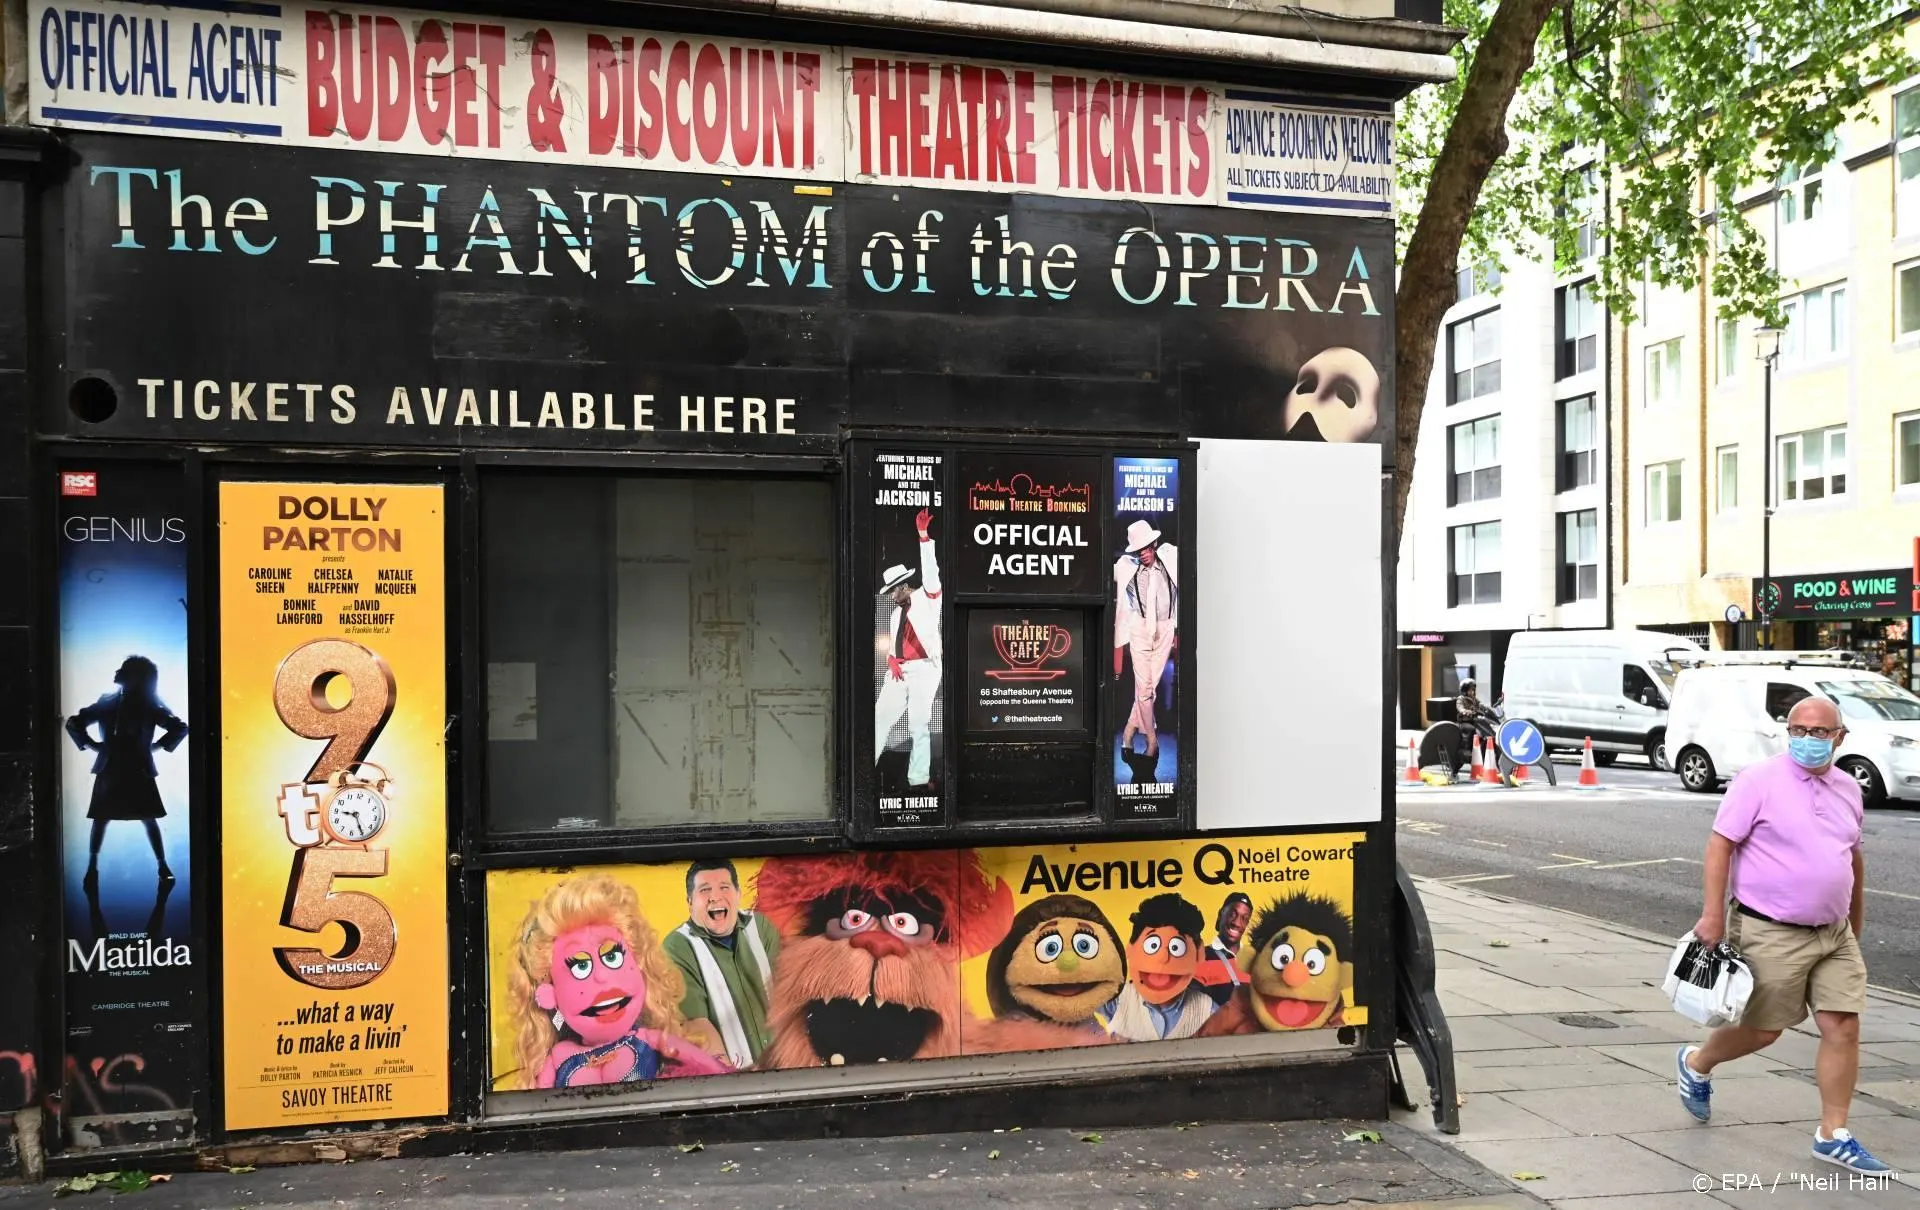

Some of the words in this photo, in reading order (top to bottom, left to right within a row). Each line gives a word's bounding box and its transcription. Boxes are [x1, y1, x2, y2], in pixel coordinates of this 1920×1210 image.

[40, 6, 177, 98] OFFICIAL
[187, 22, 282, 107] AGENT
[305, 9, 506, 149] BUDGET
[526, 27, 566, 154] &
[587, 32, 822, 171] DISCOUNT
[851, 56, 1037, 184] THEATRE
[1052, 74, 1210, 197] TICKETS
[1226, 108, 1275, 157] ADVANCE
[1279, 112, 1337, 161] BOOKINGS
[1340, 117, 1391, 164] WELCOME
[1227, 167, 1242, 186] ALL
[1245, 168, 1281, 189] TICKETS
[1284, 171, 1321, 191] SUBJECT
[1323, 174, 1335, 192] TO
[1338, 175, 1391, 196] AVAILABILITY
[90, 165, 278, 256] The
[308, 175, 834, 290] PHANTOM
[860, 209, 944, 294] of
[970, 214, 1079, 300] the
[1111, 226, 1382, 316] OPERA
[137, 378, 356, 424] TICKETS
[386, 386, 655, 431] AVAILABLE
[680, 395, 797, 435] HERE
[905, 455, 915, 463] THE
[884, 464, 934, 480] MICHAEL
[64, 474, 95, 487] RSC
[910, 481, 920, 489] THE
[1124, 473, 1168, 488] MICHAEL
[875, 489, 930, 506] JACKSON
[934, 491, 942, 507] 5
[973, 496, 1005, 511] LONDON
[1009, 497, 1042, 512] THEATRE
[1047, 498, 1086, 513] BOOKINGS
[1117, 497, 1164, 511] JACKSON
[1166, 498, 1174, 511] 5
[278, 495, 388, 522] DOLLY
[63, 516, 186, 543] GENIUS
[973, 523, 1089, 547] OFFICIAL
[263, 526, 402, 552] PARTON
[322, 555, 345, 563] presents
[988, 553, 1075, 575] AGENT
[248, 568, 292, 580] CAROLINE
[314, 568, 353, 581] CHELSEA
[378, 569, 413, 581] NATALIE
[255, 582, 285, 594] SHEEN
[308, 582, 359, 594] HALFPENNY
[375, 583, 417, 595] MCQUEEN
[1793, 580, 1837, 598] FOOD
[1839, 579, 1851, 597] &
[1852, 577, 1897, 596] WINE
[283, 599, 316, 611] BONNIE
[354, 599, 380, 611] DAVID
[1814, 600, 1848, 612] Charing
[1850, 600, 1872, 610] Cross
[276, 613, 323, 625] LANGFORD
[339, 613, 395, 625] HASSELHOFF
[1001, 625, 1049, 641] THEATRE
[1010, 641, 1040, 658] CAFE
[980, 688, 990, 696] 66
[992, 687, 1041, 697] Shaftesbury
[1042, 687, 1073, 696] Avenue
[272, 637, 398, 784] 9
[1116, 783, 1139, 795] LYRIC
[1141, 782, 1174, 795] THEATRE
[879, 797, 902, 809] LYRIC
[904, 796, 939, 808] THEATRE
[1238, 847, 1280, 864] Noël
[1019, 854, 1183, 895] Avenue
[1193, 843, 1235, 886] Q
[1238, 866, 1310, 884] Theatre
[272, 847, 398, 991] 5
[67, 937, 192, 973] Matilda
[299, 964, 324, 974] THE
[326, 961, 381, 973] MUSICAL
[92, 1002, 136, 1011] CAMBRIDGE
[137, 1000, 170, 1009] THEATRE
[277, 1001, 340, 1026] ...what
[344, 1005, 355, 1022] a
[360, 1003, 394, 1027] way
[276, 1033, 294, 1055] to
[298, 1029, 345, 1054] make
[350, 1034, 360, 1051] a
[365, 1024, 407, 1050] livin'
[260, 1073, 278, 1082] DOLLY
[279, 1071, 301, 1081] PARTON
[312, 1070, 338, 1079] PATRICIA
[339, 1068, 363, 1077] RESNICK
[374, 1066, 387, 1074] JEFF
[388, 1065, 414, 1074] CALHOUN
[282, 1087, 327, 1108] SAVOY
[331, 1083, 393, 1104] THEATRE
